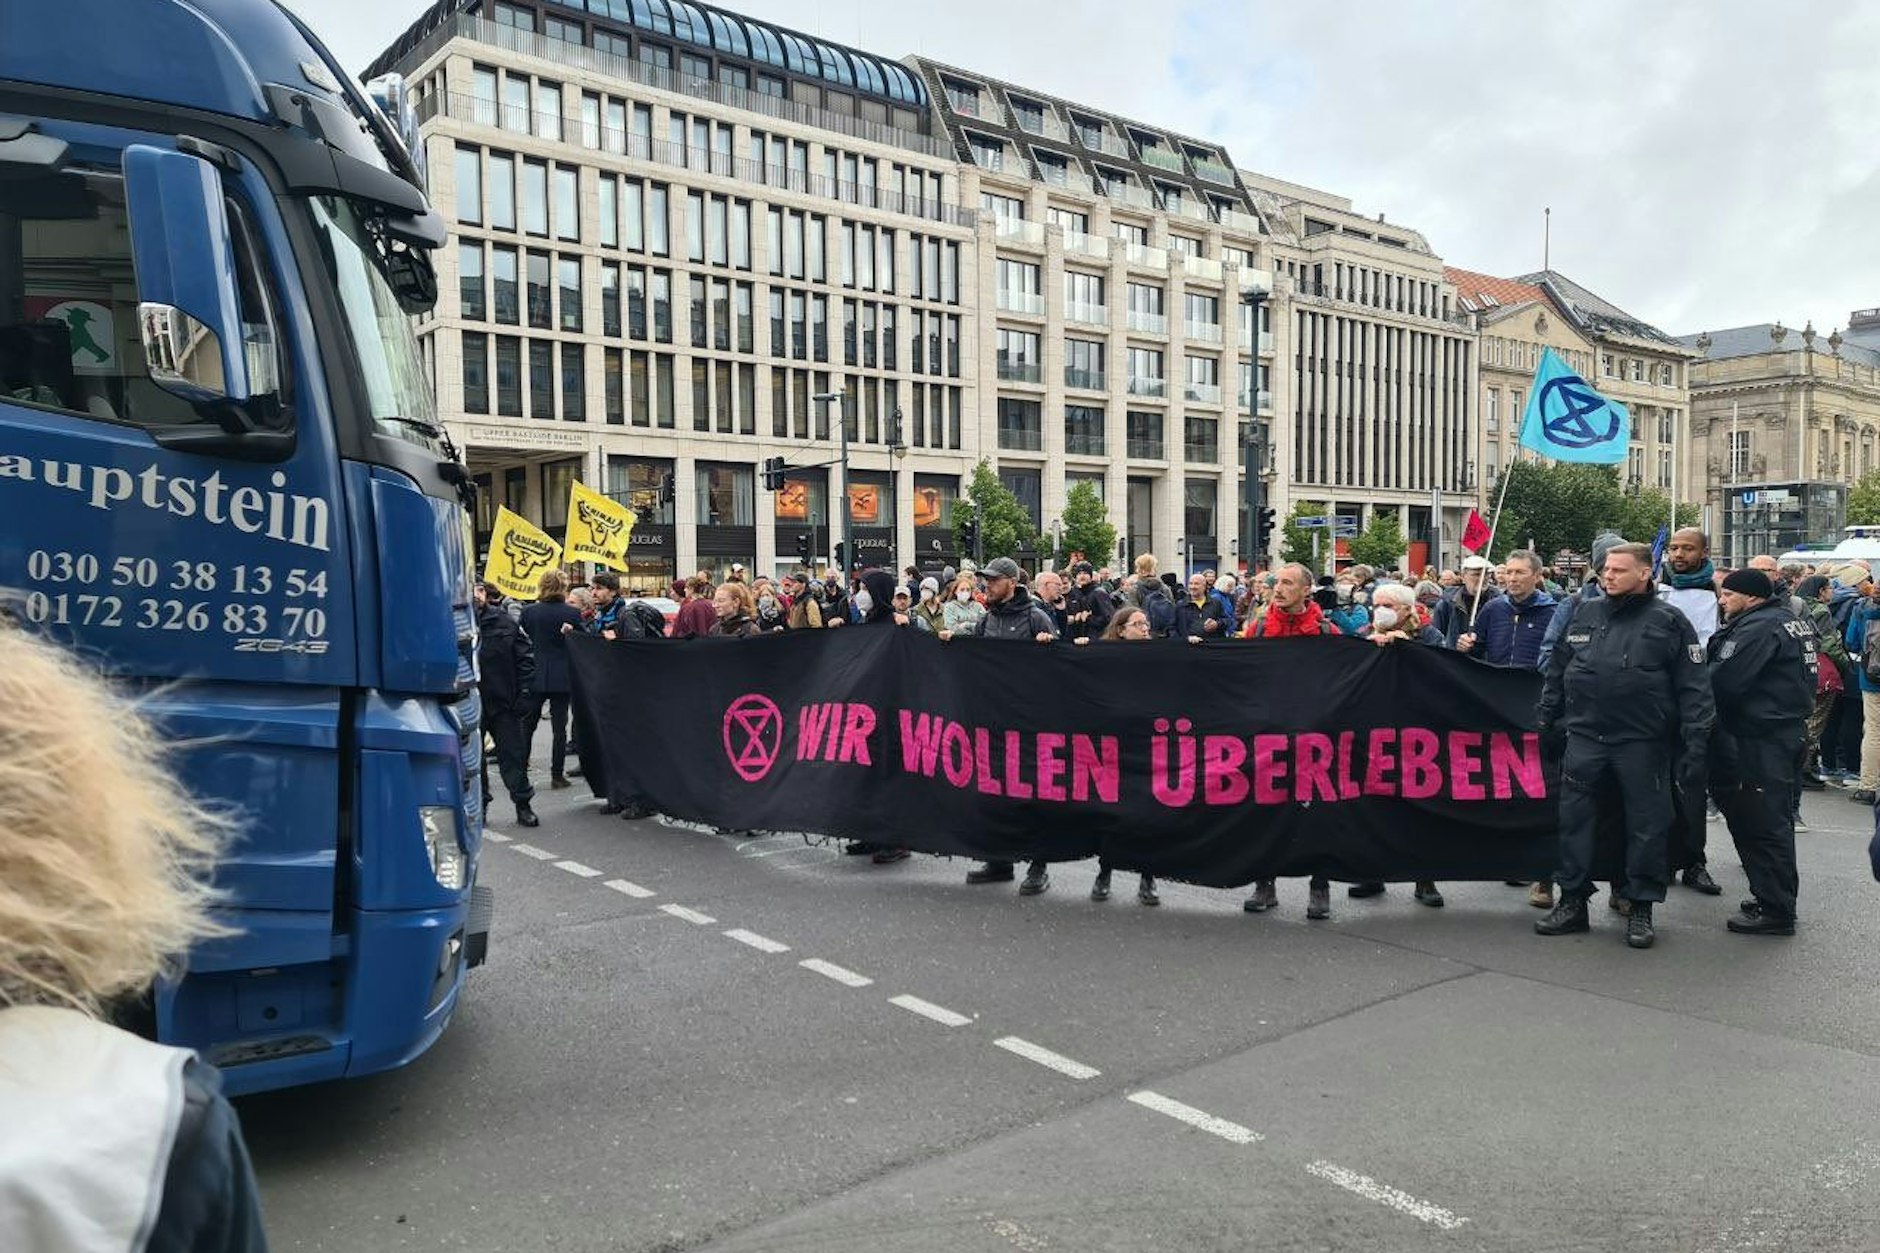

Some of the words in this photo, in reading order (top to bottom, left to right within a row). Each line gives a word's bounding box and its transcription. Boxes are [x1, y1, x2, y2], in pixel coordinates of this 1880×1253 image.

[0, 454, 330, 552] auptstein
[1743, 491, 1754, 504] U
[28, 550, 98, 584] 030
[112, 556, 158, 588] 50
[170, 560, 216, 592] 38
[231, 565, 272, 595] 13
[285, 568, 328, 599] 54
[26, 591, 123, 628] 0172
[137, 598, 209, 632] 326
[223, 603, 267, 634] 83
[282, 607, 326, 637] 70
[796, 702, 877, 766] WIR
[899, 708, 1119, 803] WOLLEN
[1151, 717, 1548, 808] ÜBERLEBEN
